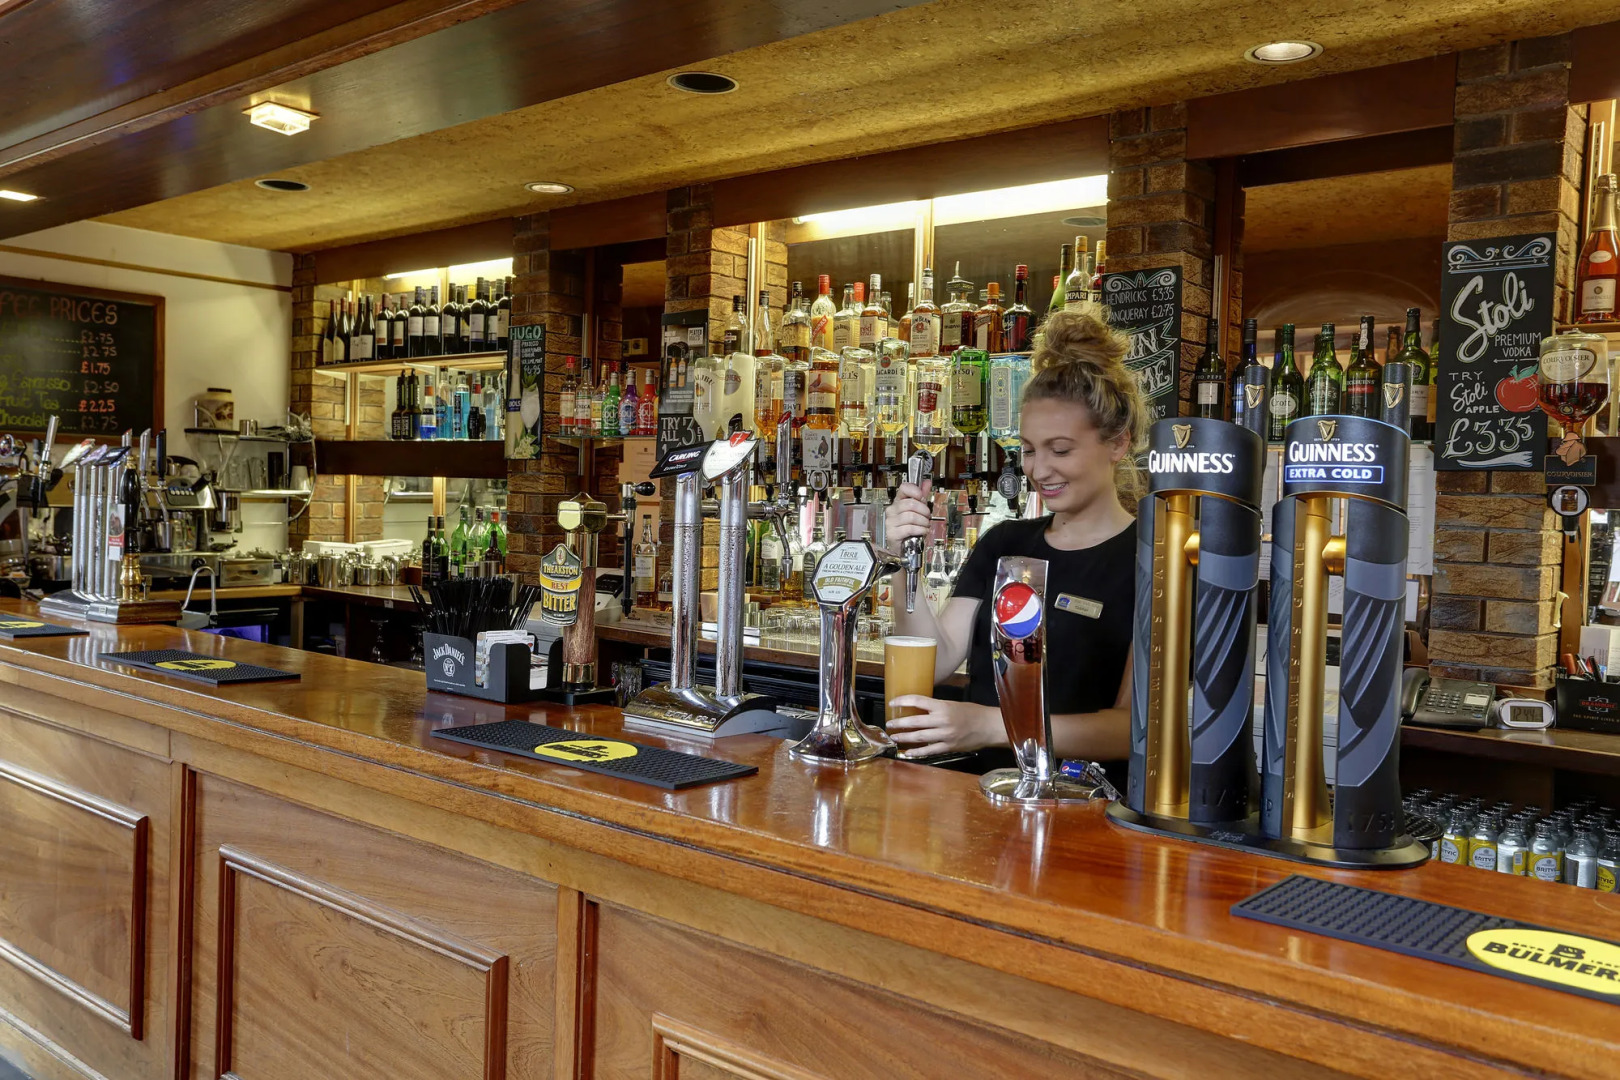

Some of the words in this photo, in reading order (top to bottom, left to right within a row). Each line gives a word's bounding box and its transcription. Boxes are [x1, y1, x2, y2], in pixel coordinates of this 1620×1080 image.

[1106, 291, 1148, 305] HENDRICKS
[50, 297, 118, 325] PRICES
[1109, 308, 1149, 323] ANQUERAY
[1451, 272, 1535, 363] Stoli
[510, 326, 541, 340] HUGO
[1495, 332, 1542, 347] PREMIUM
[1503, 347, 1531, 357] VODKA
[1449, 371, 1483, 380] TRY
[1450, 382, 1488, 412] Stoli
[1465, 405, 1499, 413] APPLE
[661, 417, 681, 430] TRY
[661, 430, 680, 442] ALL
[669, 450, 701, 462] CARLING
[1289, 441, 1376, 463] GUINNESS
[1149, 450, 1234, 474] GUINNESS
[1289, 468, 1326, 478] EXTRA
[1331, 468, 1372, 479] COLD
[543, 563, 578, 576] THEAKSTON
[829, 563, 853, 571] GOLDEN
[854, 564, 867, 572] ALE
[552, 581, 569, 590] BEST
[542, 591, 576, 612] BITTER
[433, 645, 445, 661] JACK
[444, 643, 466, 666] DANIEL'S
[1482, 941, 1620, 982] BULMER
